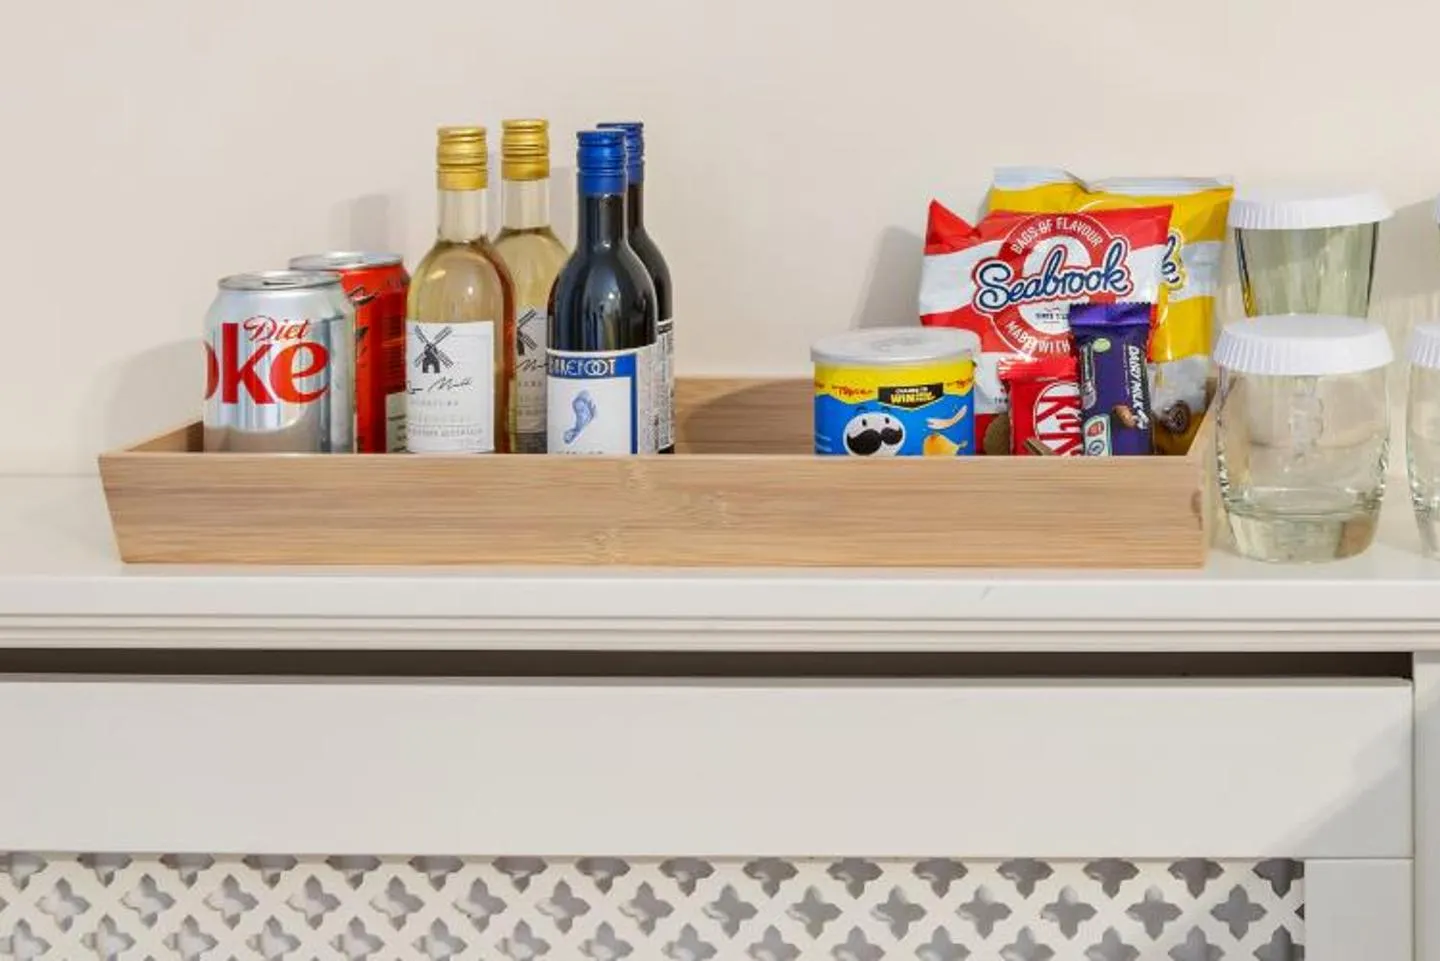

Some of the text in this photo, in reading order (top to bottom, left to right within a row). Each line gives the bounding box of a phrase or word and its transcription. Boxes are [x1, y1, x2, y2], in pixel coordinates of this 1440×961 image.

[1038, 219, 1053, 234] OF
[1056, 217, 1103, 247] FLAVOUR
[978, 241, 1127, 308] Seabrook
[243, 315, 309, 340] Diet
[1038, 339, 1070, 353] WITH
[1128, 345, 1144, 409] DAIRY MILK
[890, 393, 915, 404] WIN
